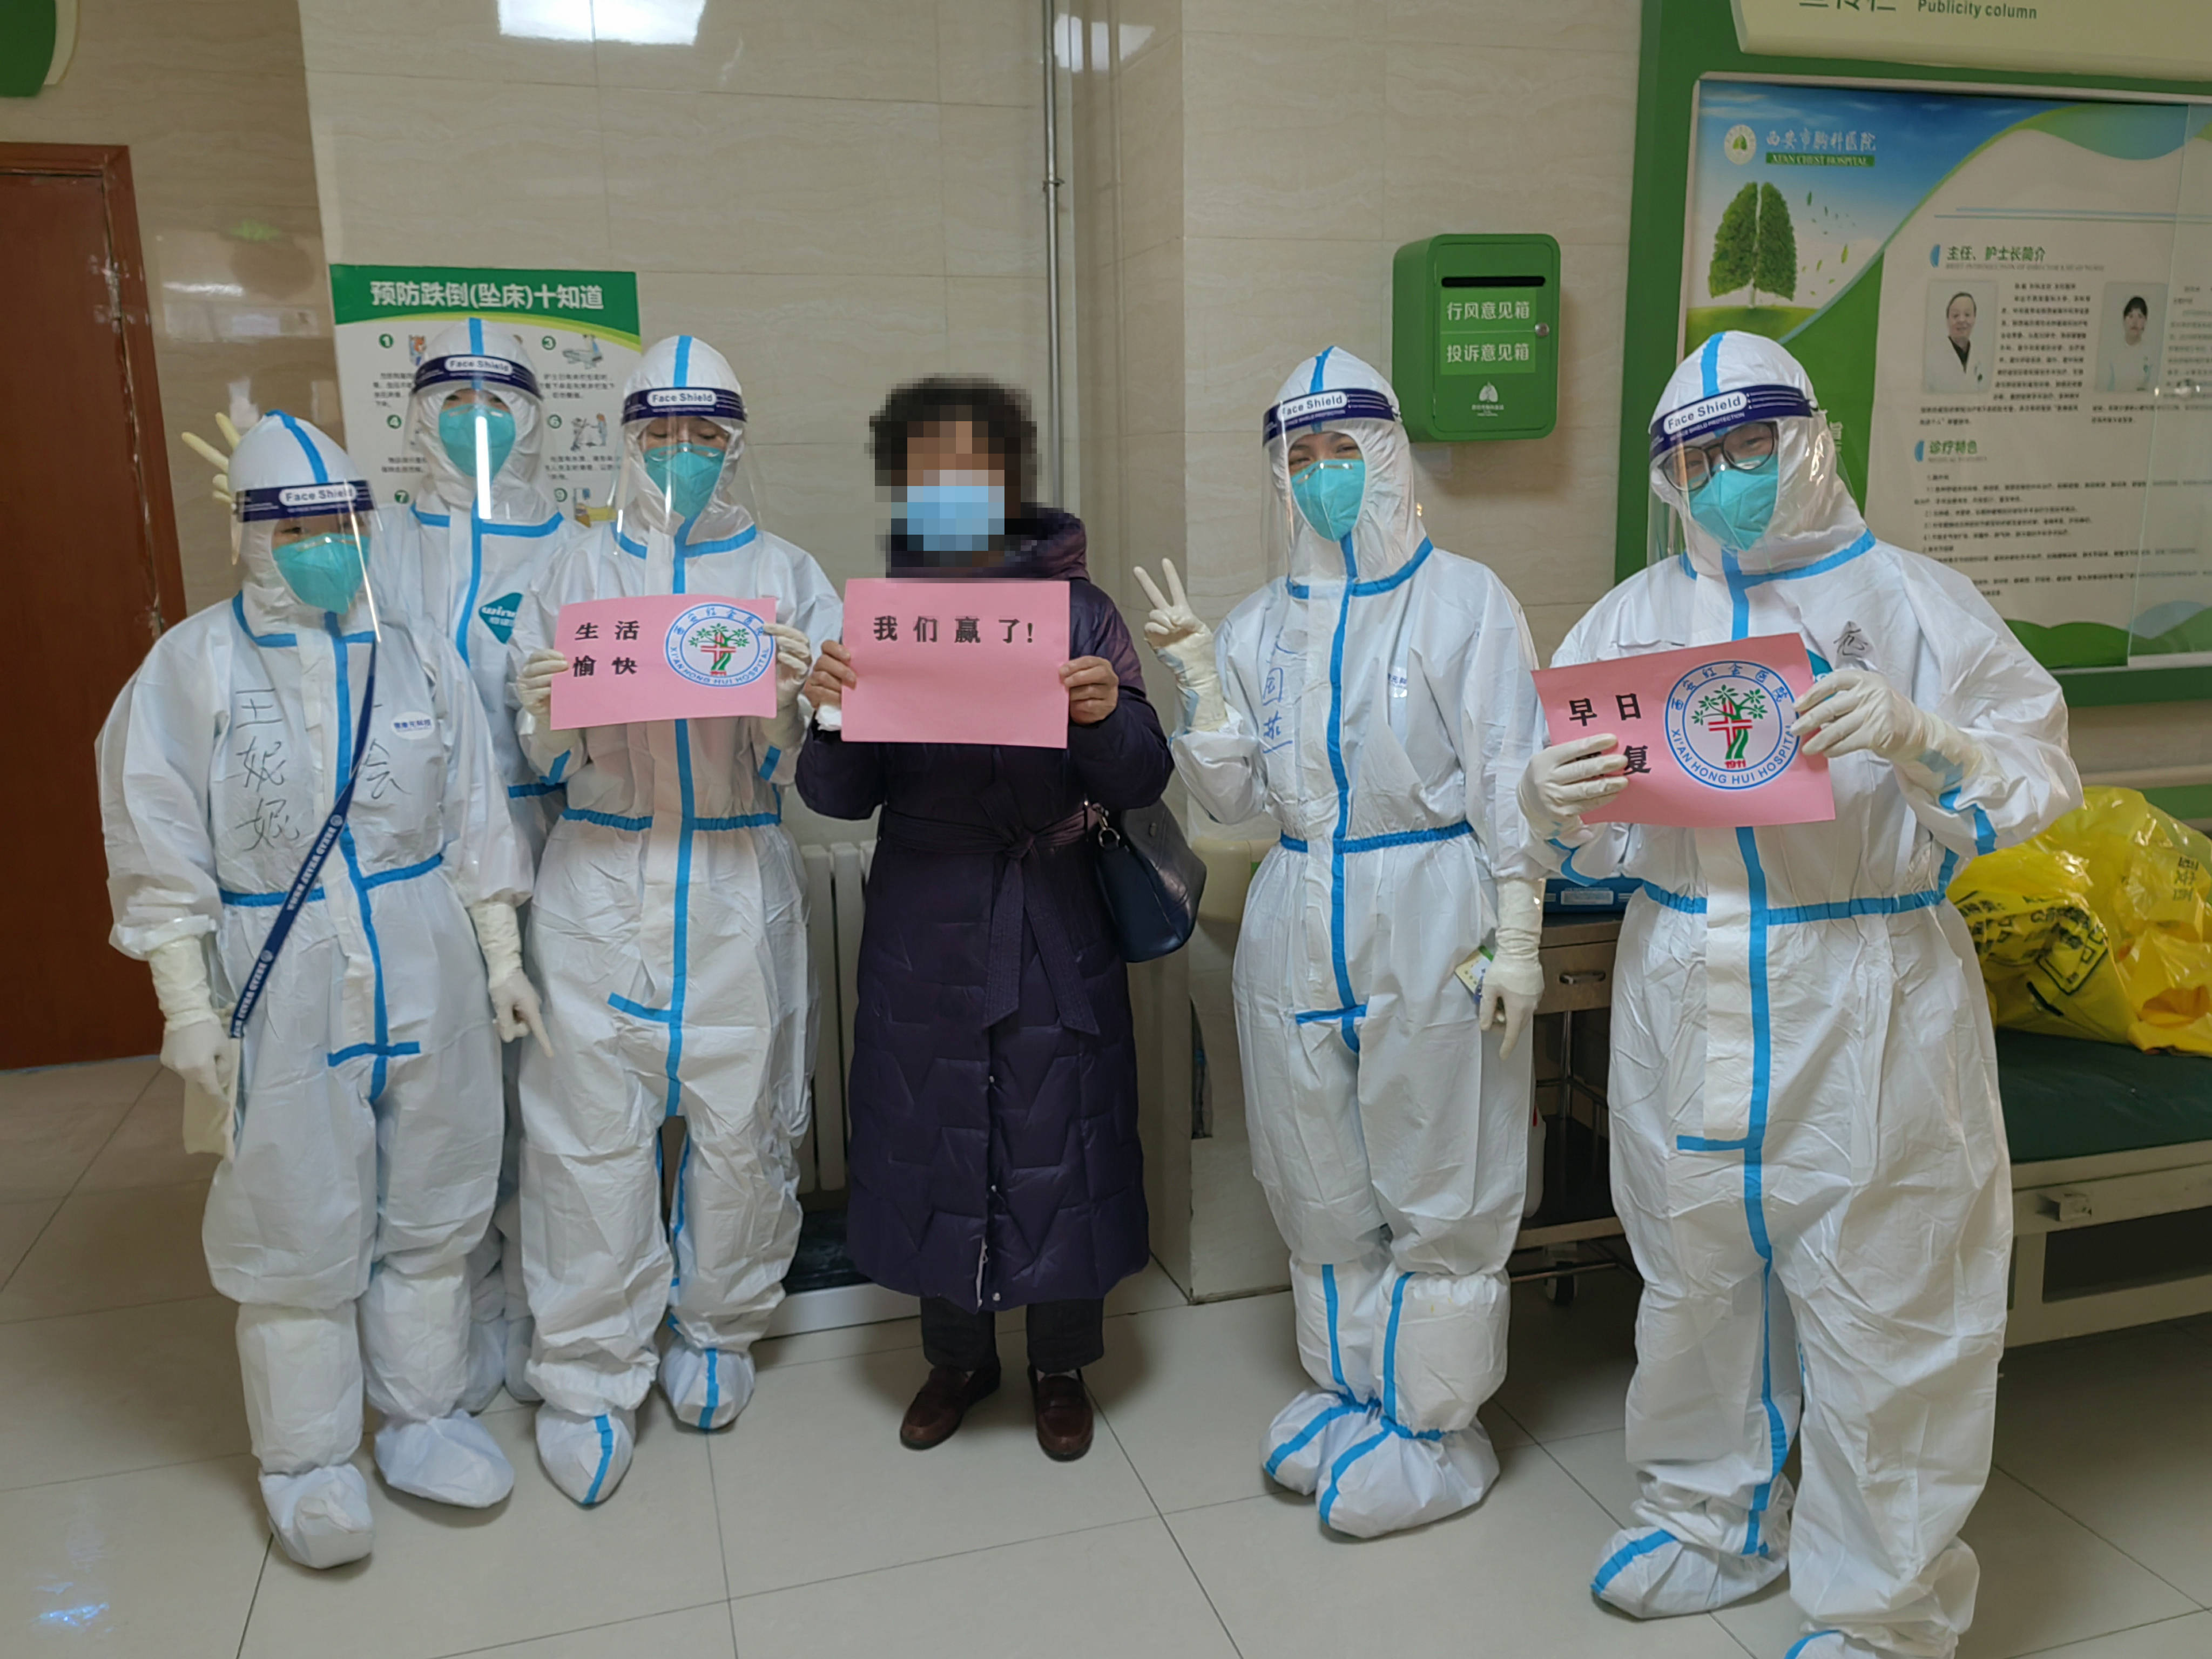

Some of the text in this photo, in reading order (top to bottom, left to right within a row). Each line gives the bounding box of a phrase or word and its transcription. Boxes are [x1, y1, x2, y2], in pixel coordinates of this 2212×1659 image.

[1918, 0, 2037, 19] Publicity column
[1947, 246, 2046, 262] 主任、护士长简介
[370, 281, 604, 309] 预防跌倒(坠床)十知道
[1447, 301, 1530, 320] 行风意见箱
[1447, 343, 1529, 362] 投诉意见箱
[450, 360, 474, 368] Face
[652, 393, 713, 403] Face Shield
[1282, 395, 1343, 416] Face Shield
[1668, 396, 1742, 430] Face Shield
[1930, 440, 1978, 455] 诊疗特色
[285, 493, 315, 502] Face
[575, 621, 640, 641] 生活
[873, 616, 1033, 643] 我们赢了!
[572, 655, 638, 677] 愉快
[683, 669, 711, 683] HONG
[735, 648, 770, 683] HOSPITAL
[1569, 692, 1642, 727] 早日
[1672, 729, 1692, 763] XI'AN
[1691, 761, 1727, 784] HONG
[1732, 772, 1755, 784] HUI
[1725, 759, 1746, 769] 1911
